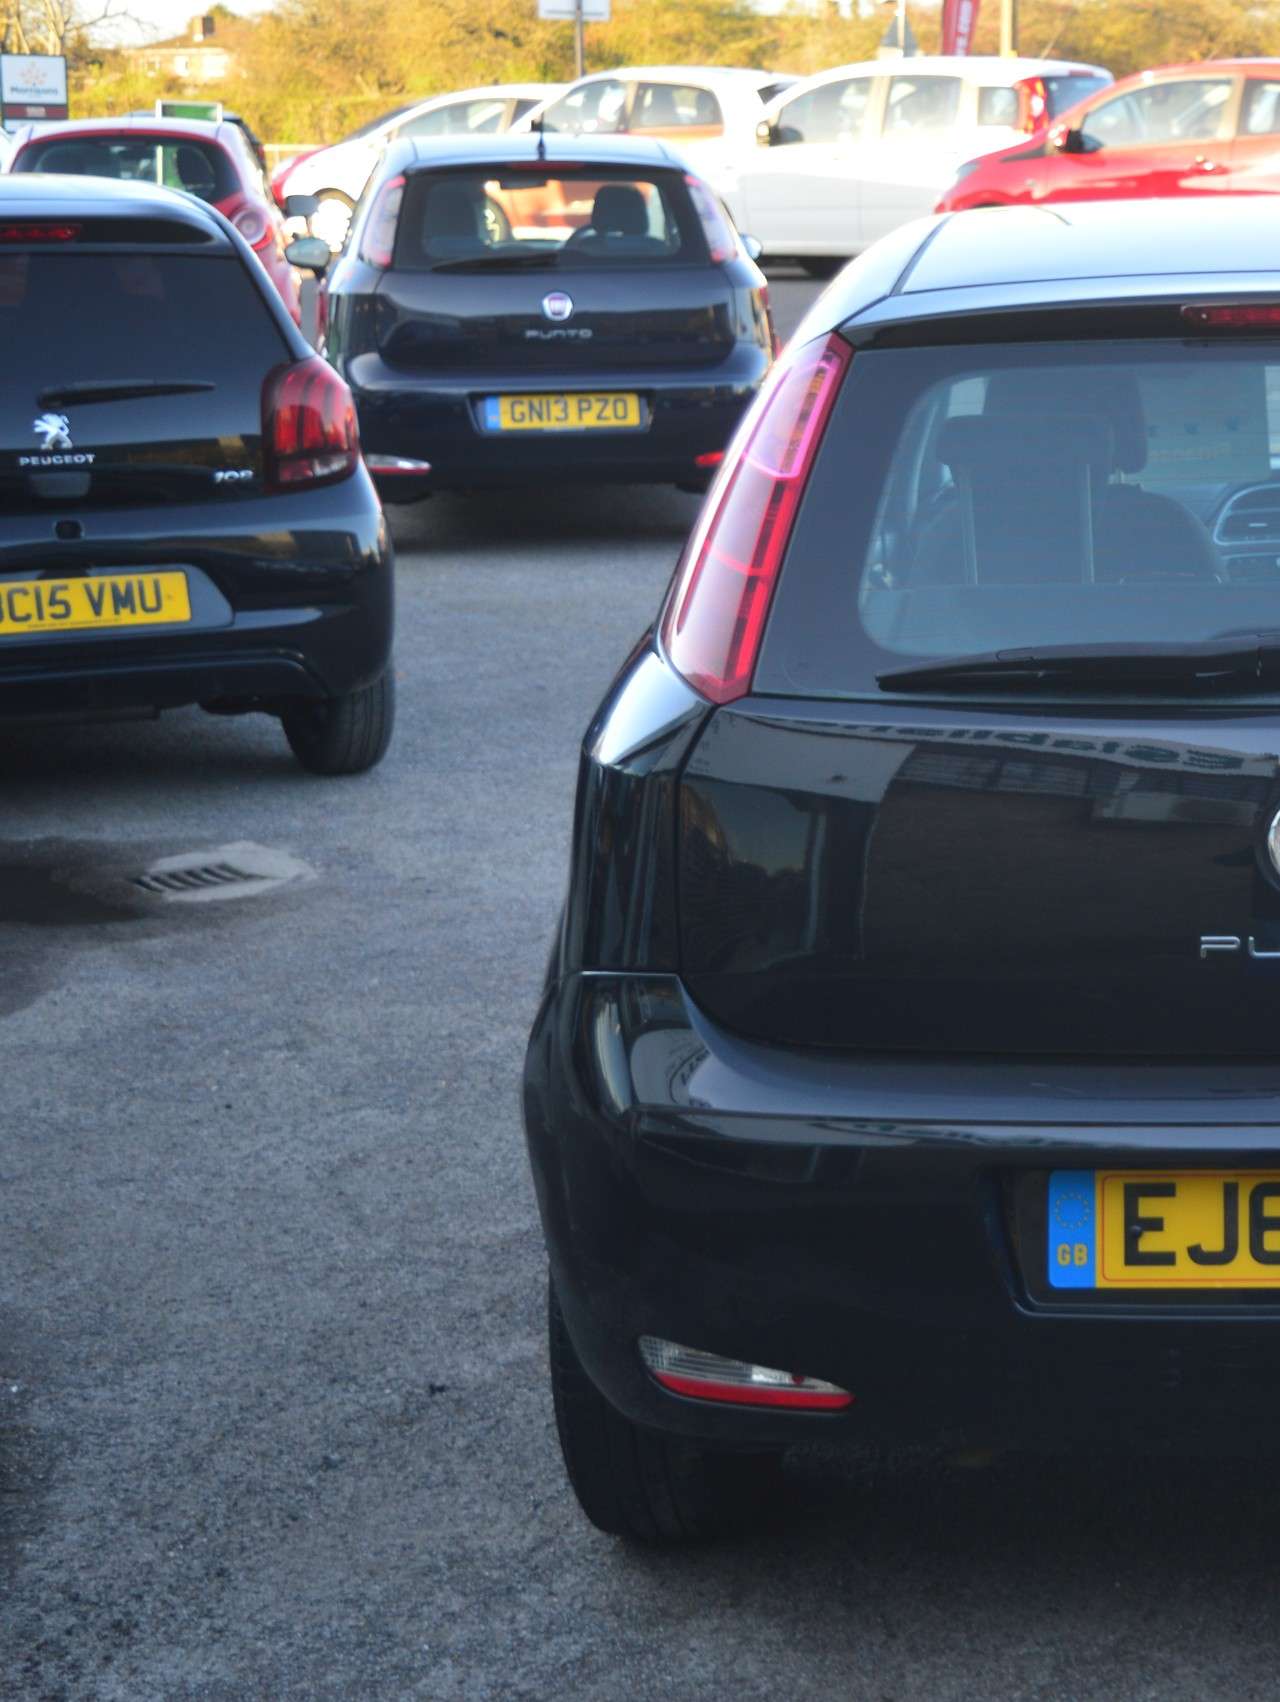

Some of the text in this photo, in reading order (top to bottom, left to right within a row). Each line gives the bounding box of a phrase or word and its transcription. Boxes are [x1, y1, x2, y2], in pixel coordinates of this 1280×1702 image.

[511, 397, 628, 423] GN13 PZO
[19, 454, 95, 466] PEUGEOT
[0, 578, 163, 623] C15 VMU
[1056, 1243, 1088, 1266] GB
